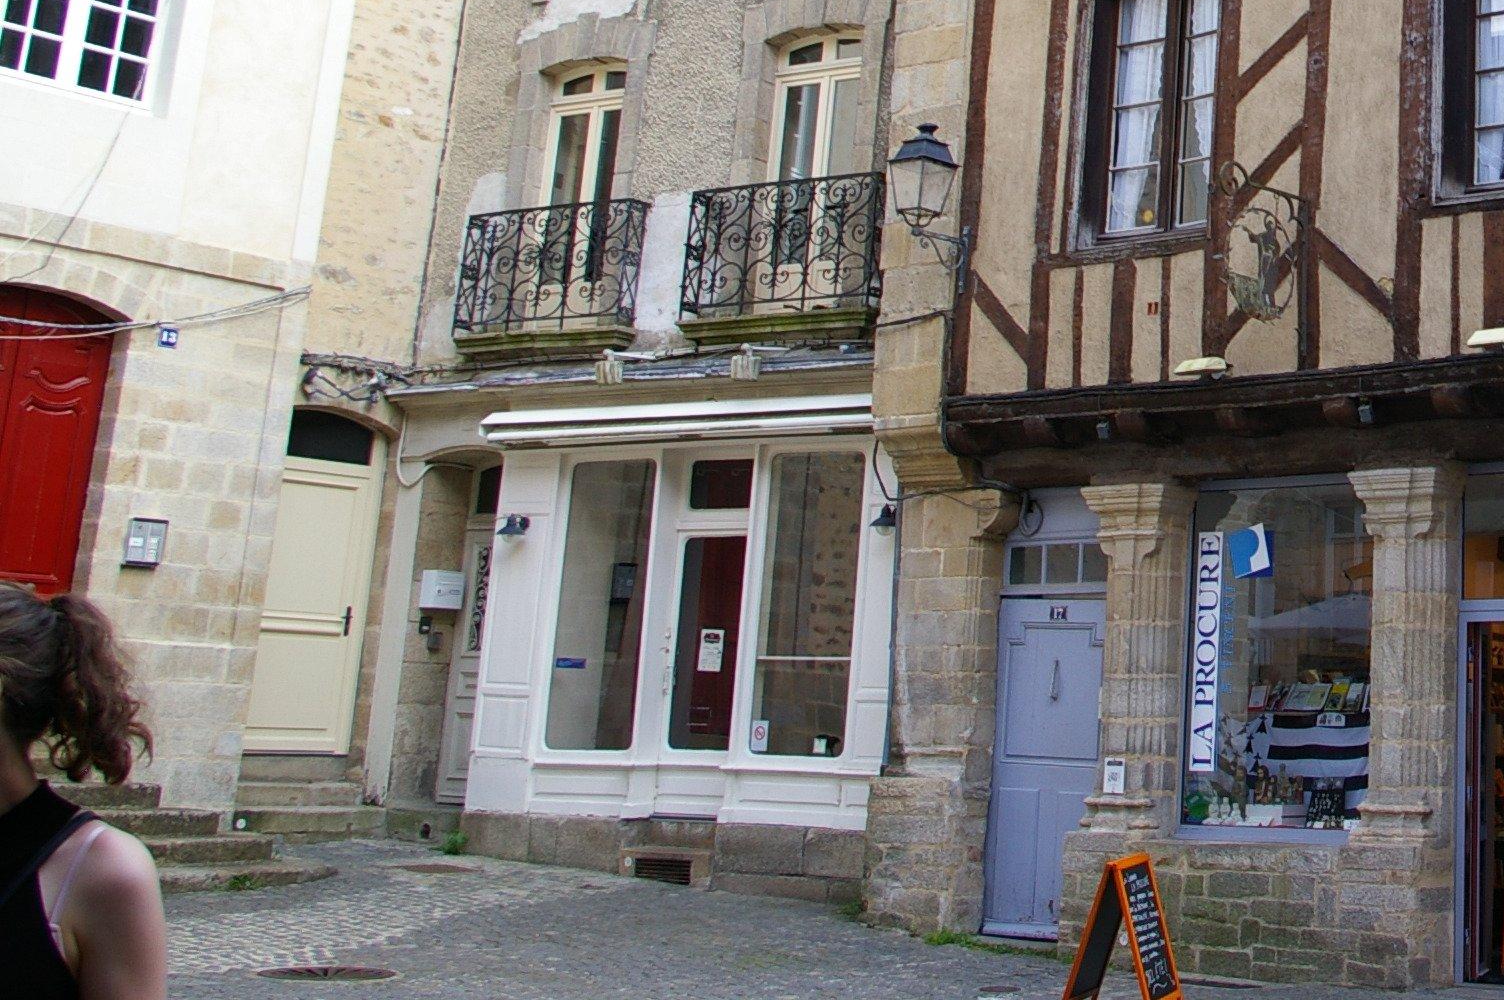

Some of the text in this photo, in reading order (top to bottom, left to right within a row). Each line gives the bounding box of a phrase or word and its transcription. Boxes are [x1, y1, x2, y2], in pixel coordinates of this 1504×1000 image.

[161, 330, 176, 343] 13
[1192, 534, 1221, 768] LA PROCURE
